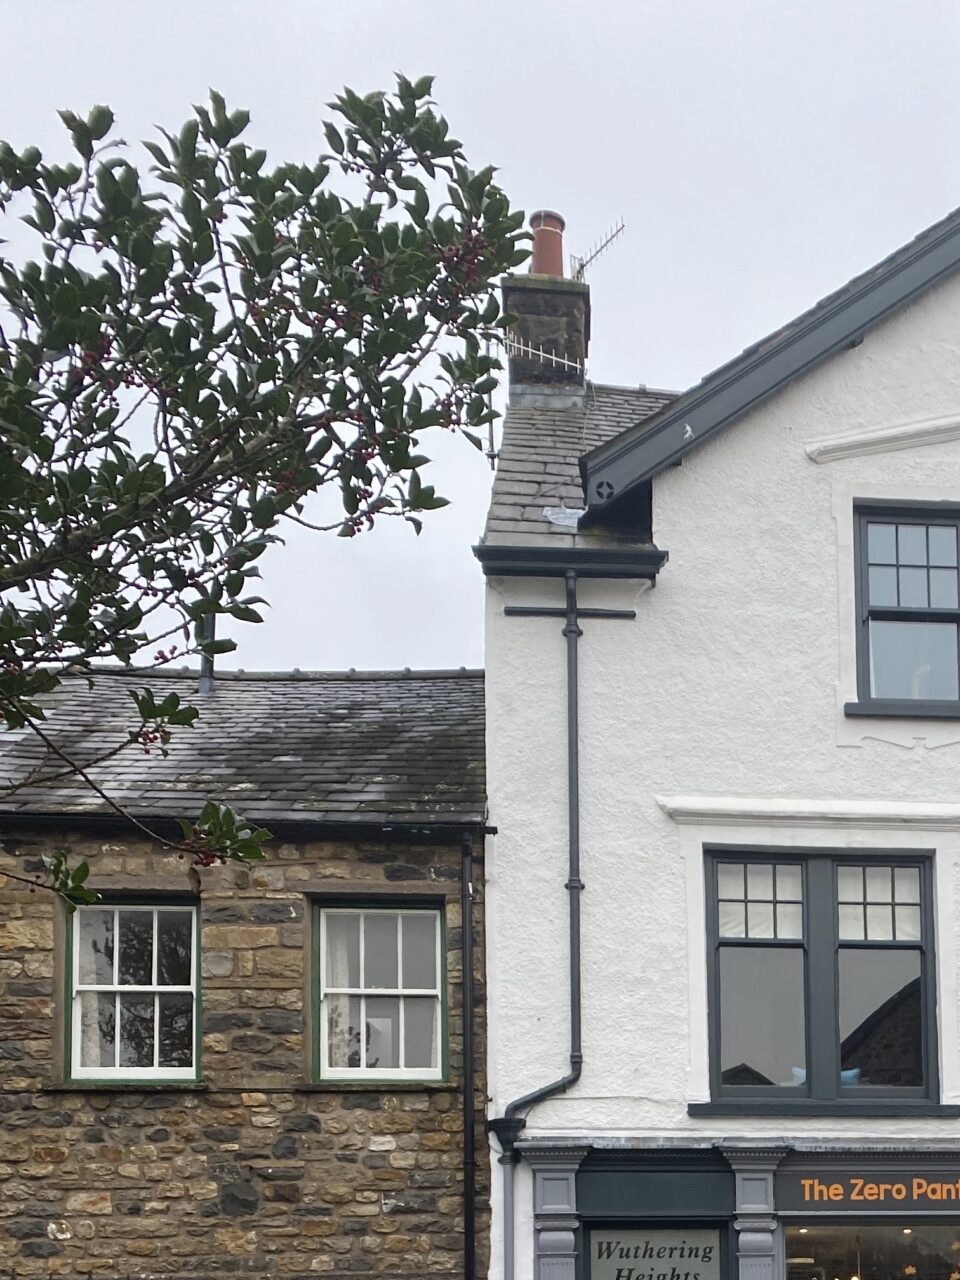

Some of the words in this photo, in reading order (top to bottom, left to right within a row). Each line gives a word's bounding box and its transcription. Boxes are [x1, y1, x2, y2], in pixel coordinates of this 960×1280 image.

[801, 1179, 844, 1201] The
[850, 1178, 907, 1201] Zero
[597, 1240, 714, 1263] Wuthering
